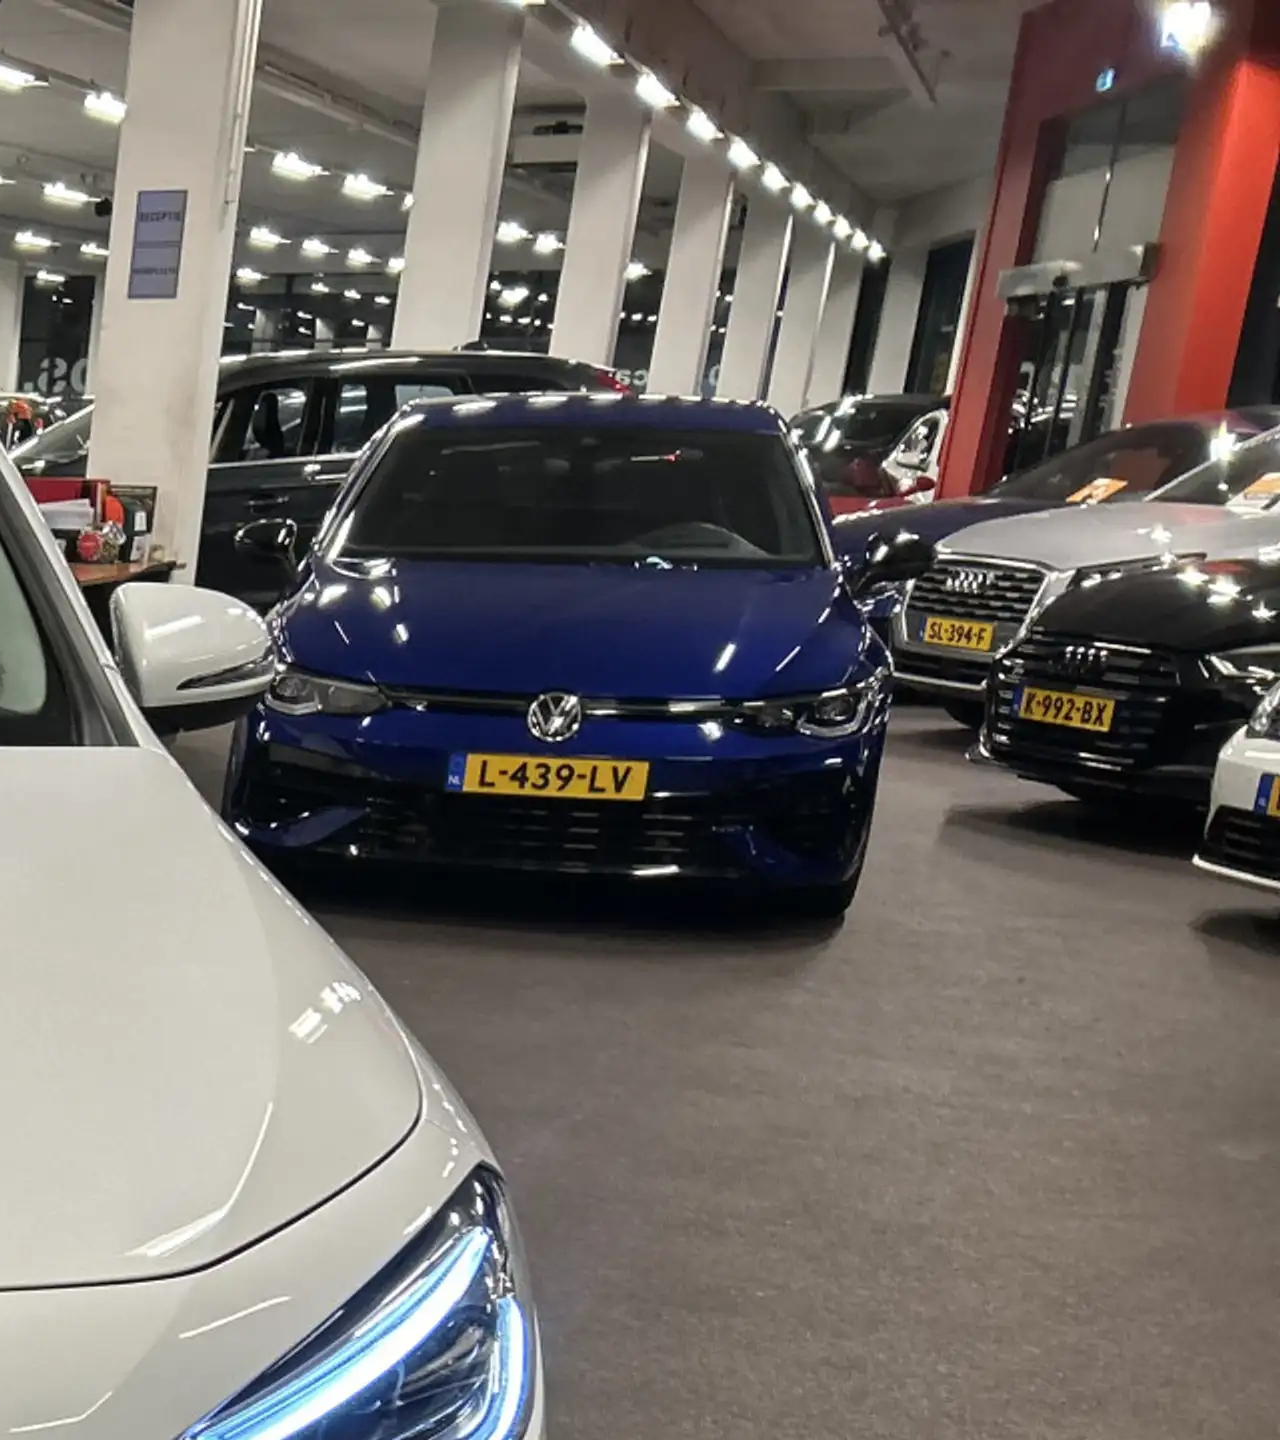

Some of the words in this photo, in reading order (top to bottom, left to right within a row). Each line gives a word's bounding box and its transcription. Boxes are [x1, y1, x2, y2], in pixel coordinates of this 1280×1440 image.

[928, 622, 987, 646] SL-394-F
[1024, 692, 1107, 726] K-992-BX
[478, 760, 632, 793] L-439-LV
